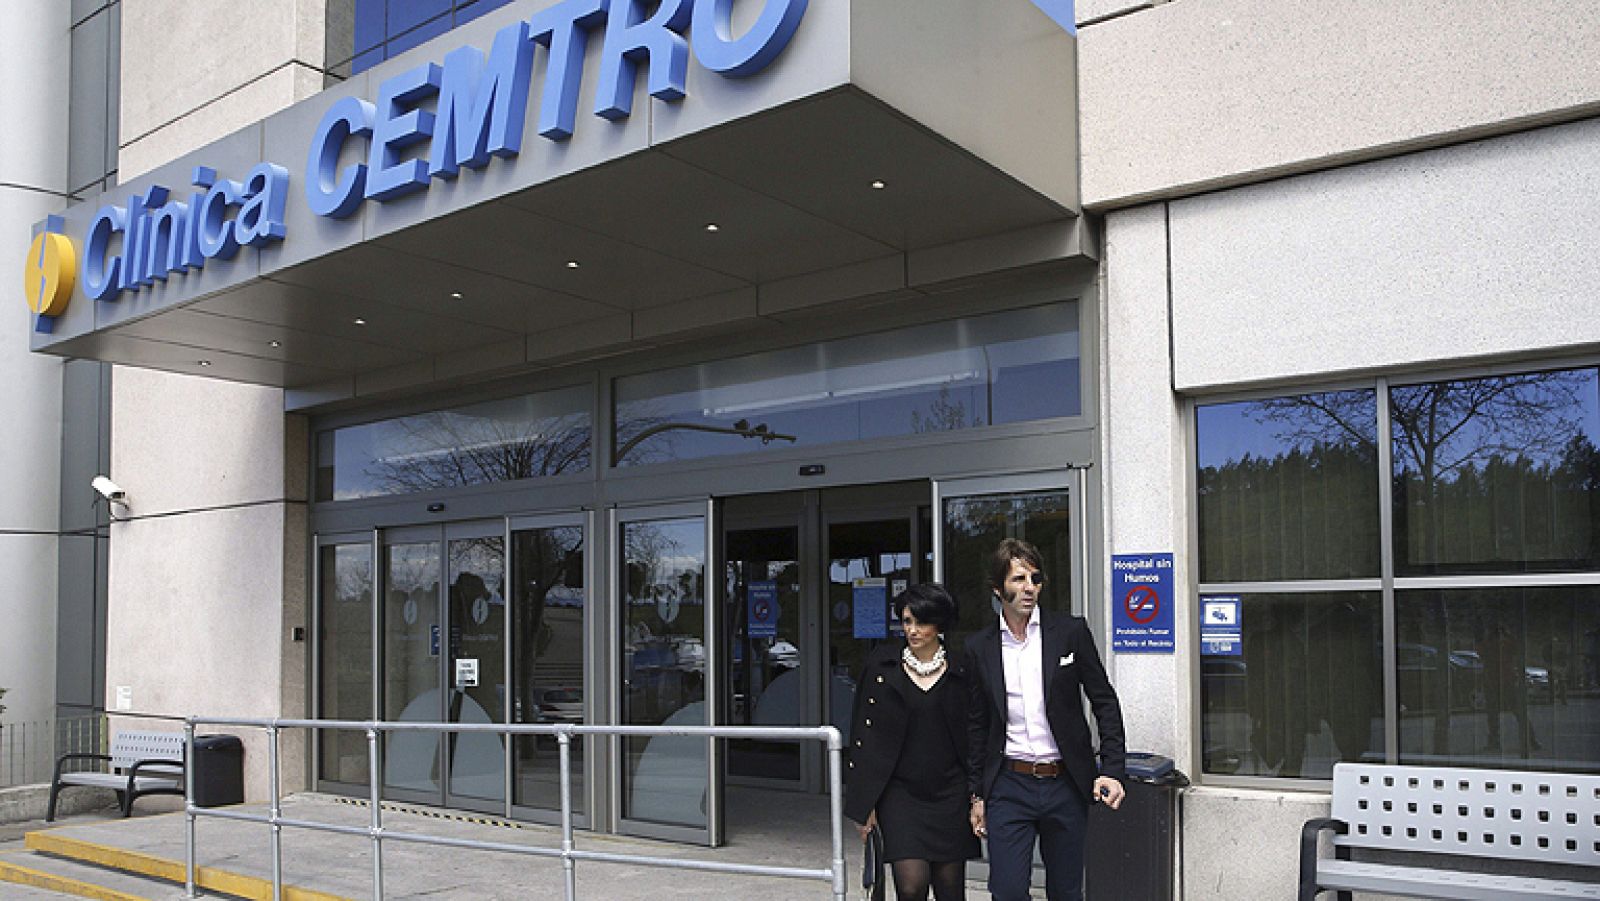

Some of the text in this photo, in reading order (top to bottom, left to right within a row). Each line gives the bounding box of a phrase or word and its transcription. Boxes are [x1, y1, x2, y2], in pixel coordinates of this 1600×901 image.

[82, 162, 289, 300] Clínica
[1114, 558, 1153, 571] Hospital
[1124, 573, 1159, 583] Humos
